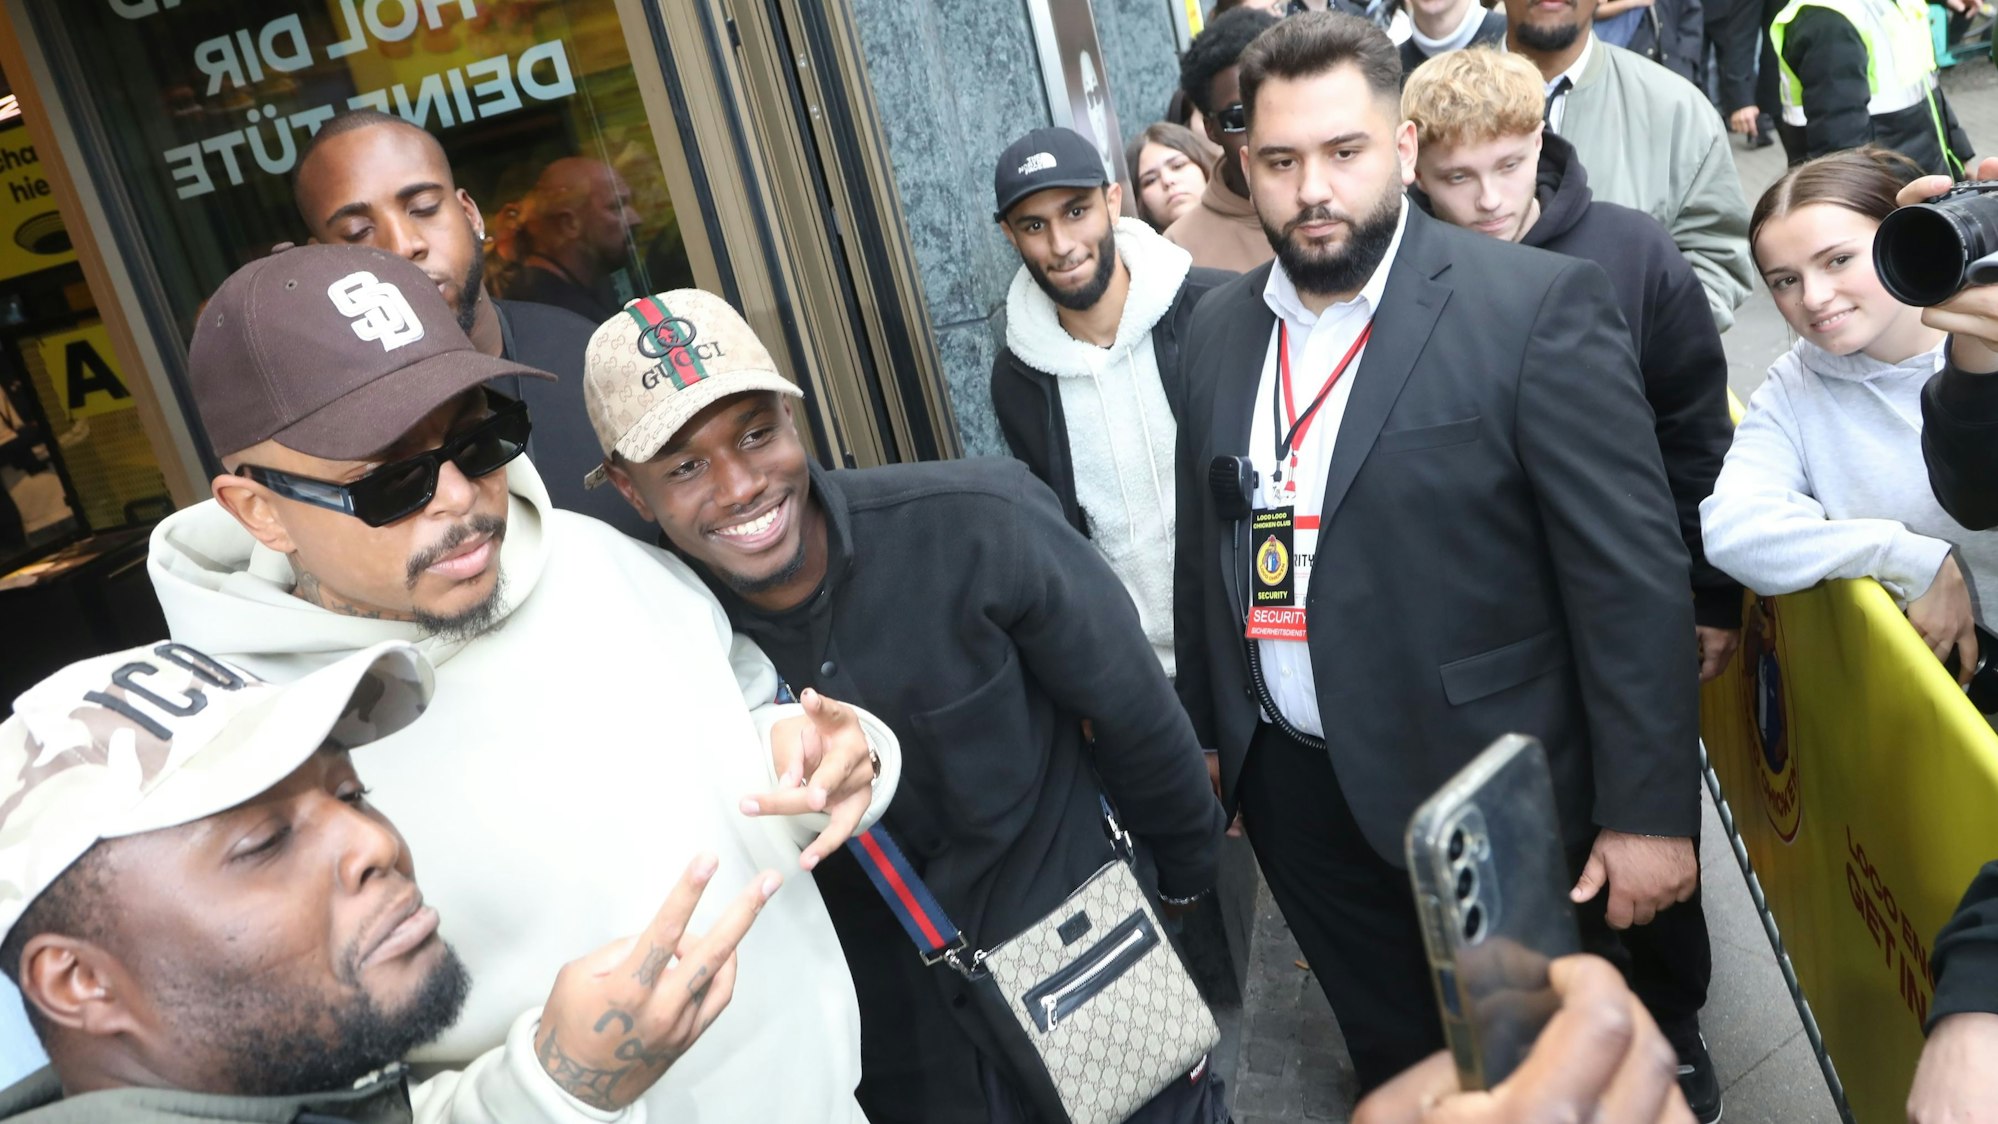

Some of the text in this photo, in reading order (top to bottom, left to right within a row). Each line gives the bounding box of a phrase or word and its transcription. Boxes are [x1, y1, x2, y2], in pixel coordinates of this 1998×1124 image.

[642, 342, 726, 390] GUCCI
[1272, 512, 1287, 520] LOCO
[1253, 521, 1276, 529] CHICKEN
[1258, 591, 1288, 600] SECURITY
[1253, 609, 1306, 624] SECURITY
[1251, 627, 1306, 637] SICHERHEITSDIENST
[1846, 824, 1899, 924] LOCO
[1846, 861, 1929, 1040] GET IN
